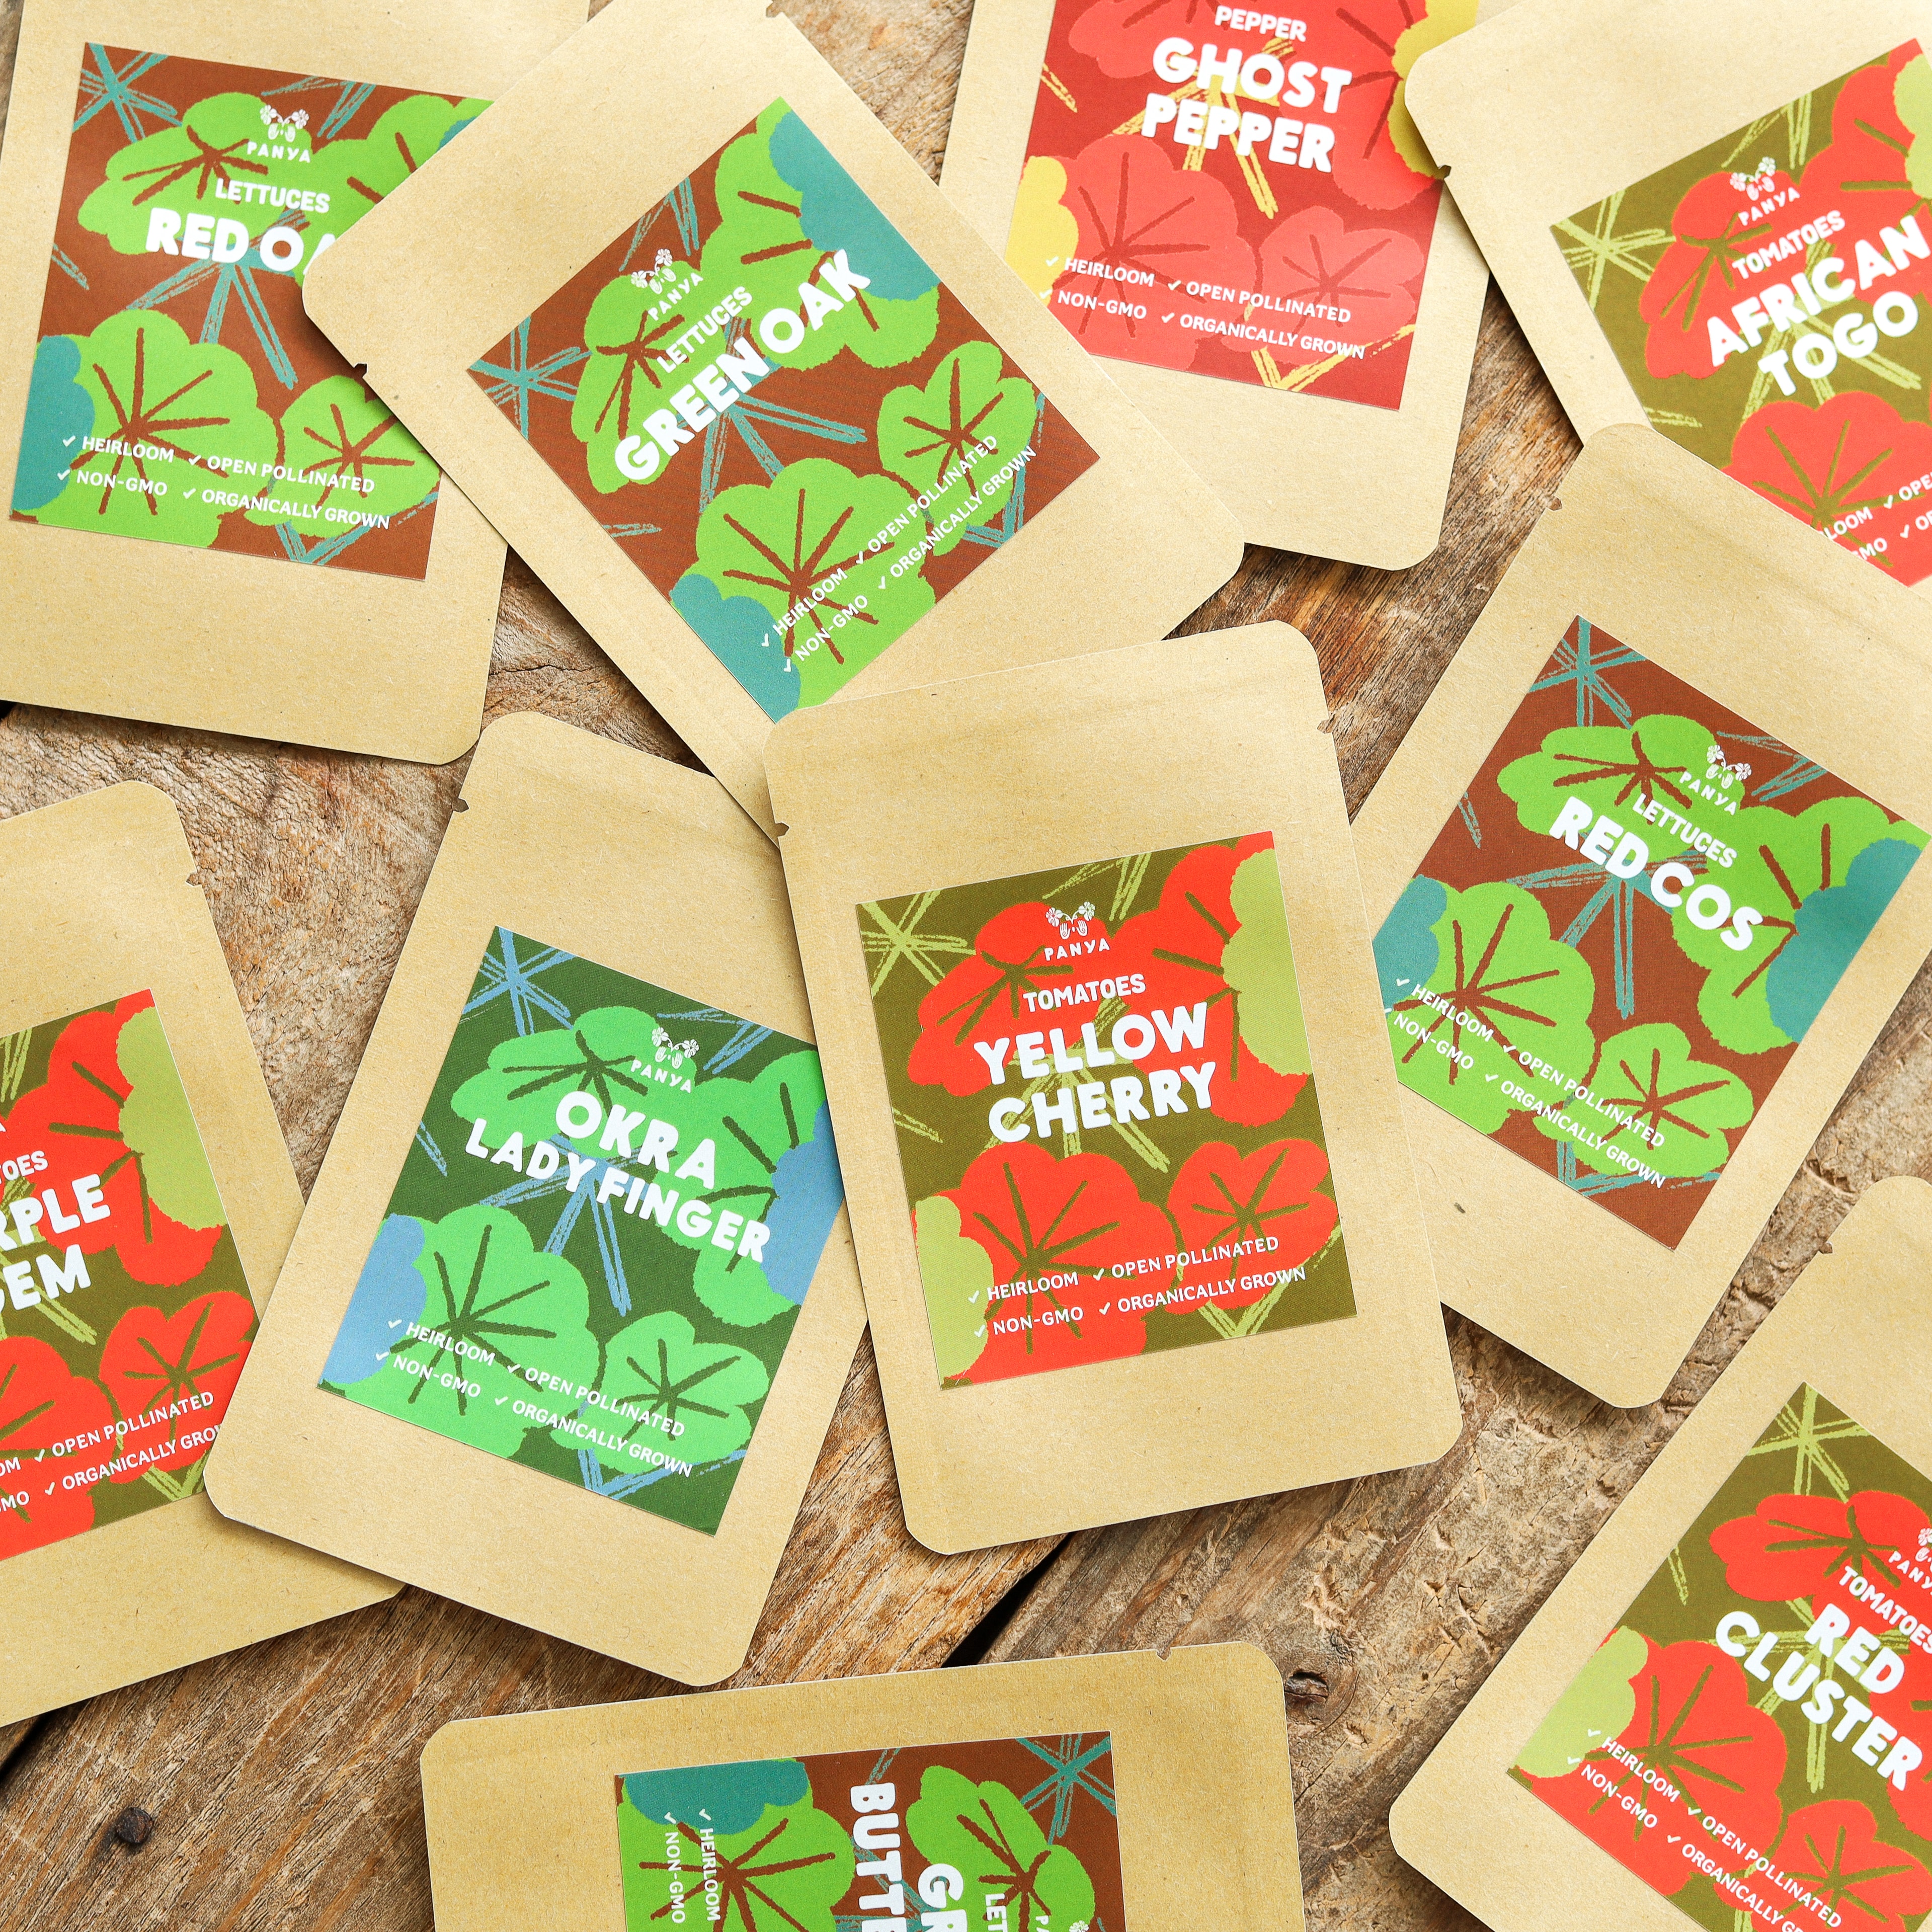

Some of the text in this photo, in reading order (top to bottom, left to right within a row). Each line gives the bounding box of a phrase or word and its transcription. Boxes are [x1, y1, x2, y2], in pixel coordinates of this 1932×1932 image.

[1215, 6, 1307, 42] PEPPER
[1153, 37, 1352, 113] GHOST
[247, 141, 310, 163] PANYA
[1141, 93, 1335, 173] PEPPER
[215, 178, 331, 213] LETTUCES
[1738, 188, 1800, 225] PANYA
[145, 207, 250, 264] RED
[1732, 210, 1845, 279] TOMATOES
[648, 272, 703, 320] PANYA
[1064, 257, 1155, 287] HEIRLOOM
[1186, 281, 1351, 323] OPEN POLLINATED
[1707, 214, 1931, 367] AFRICAN
[657, 286, 753, 373] LETTUCES
[1058, 290, 1147, 319] NON-GMO
[1180, 314, 1365, 359] ORGANICALLY GROWN
[614, 249, 872, 480] GREEN OAK
[1757, 291, 1918, 396] TOGO
[82, 436, 174, 462] HEIRLOOM
[207, 455, 375, 493] OPEN POLLINATED
[76, 469, 168, 496] NON-GMO
[201, 489, 390, 530] ORGANICALLY GROWN
[867, 435, 997, 552] OPEN POLLINATED
[890, 445, 1036, 577] ORGANICALLY GROWN
[1899, 472, 1932, 500] OPE
[1817, 506, 1873, 540] LOOM
[772, 568, 848, 636] HEIRLOOM
[794, 595, 868, 661] NON-GMO
[1679, 771, 1737, 815] PANYA
[1633, 793, 1737, 868] LETTUCES
[1549, 796, 1763, 951] RED COS
[1044, 938, 1110, 961] PANYA
[1023, 974, 1146, 1012] TOMATOES
[1411, 983, 1494, 1042] HEIRLOOM
[974, 1002, 1207, 1085] YELLOW
[1394, 1013, 1474, 1069] NON-GMO
[630, 1059, 691, 1093] PANYA
[988, 1061, 1216, 1143] CHERRY
[1518, 1051, 1665, 1147] OPEN POLLINATED
[555, 1090, 715, 1190] OKRA
[1501, 1080, 1666, 1188] ORGANICALLY GROWN
[0, 1151, 48, 1184] OES
[465, 1117, 771, 1263] LADY FINGER
[0, 1244, 91, 1310] EM
[987, 1271, 1079, 1301] HEIRLOOM
[1111, 1236, 1278, 1278] OPEN POLLINATED
[1118, 1266, 1306, 1312] ORGANICALLY GROWN
[405, 1321, 496, 1366] HEIRLOOM
[993, 1307, 1083, 1335] NON-GMO
[393, 1354, 481, 1397] NON-GMO
[525, 1367, 685, 1436] OPEN POLLINATED
[52, 1392, 213, 1457] OPEN POLLINATED
[512, 1400, 693, 1478] ORGANICALLY GROWN
[62, 1425, 220, 1490] ORGANICALLY GRO
[0, 1491, 29, 1512] MO
[1889, 1551, 1932, 1589] PANY
[1804, 1603, 1905, 1694] RED
[1715, 1611, 1923, 1791] CLUSTER
[1581, 1764, 1658, 1828] NON-GMO
[1601, 1736, 1680, 1802] HEIRLOOM
[665, 1832, 686, 1923] NON-GMO
[700, 1828, 721, 1921] HEIRLOOM
[1682, 1843, 1784, 1924] ORGANICALLY
[1702, 1816, 1841, 1927] OPEN POLLINATED
